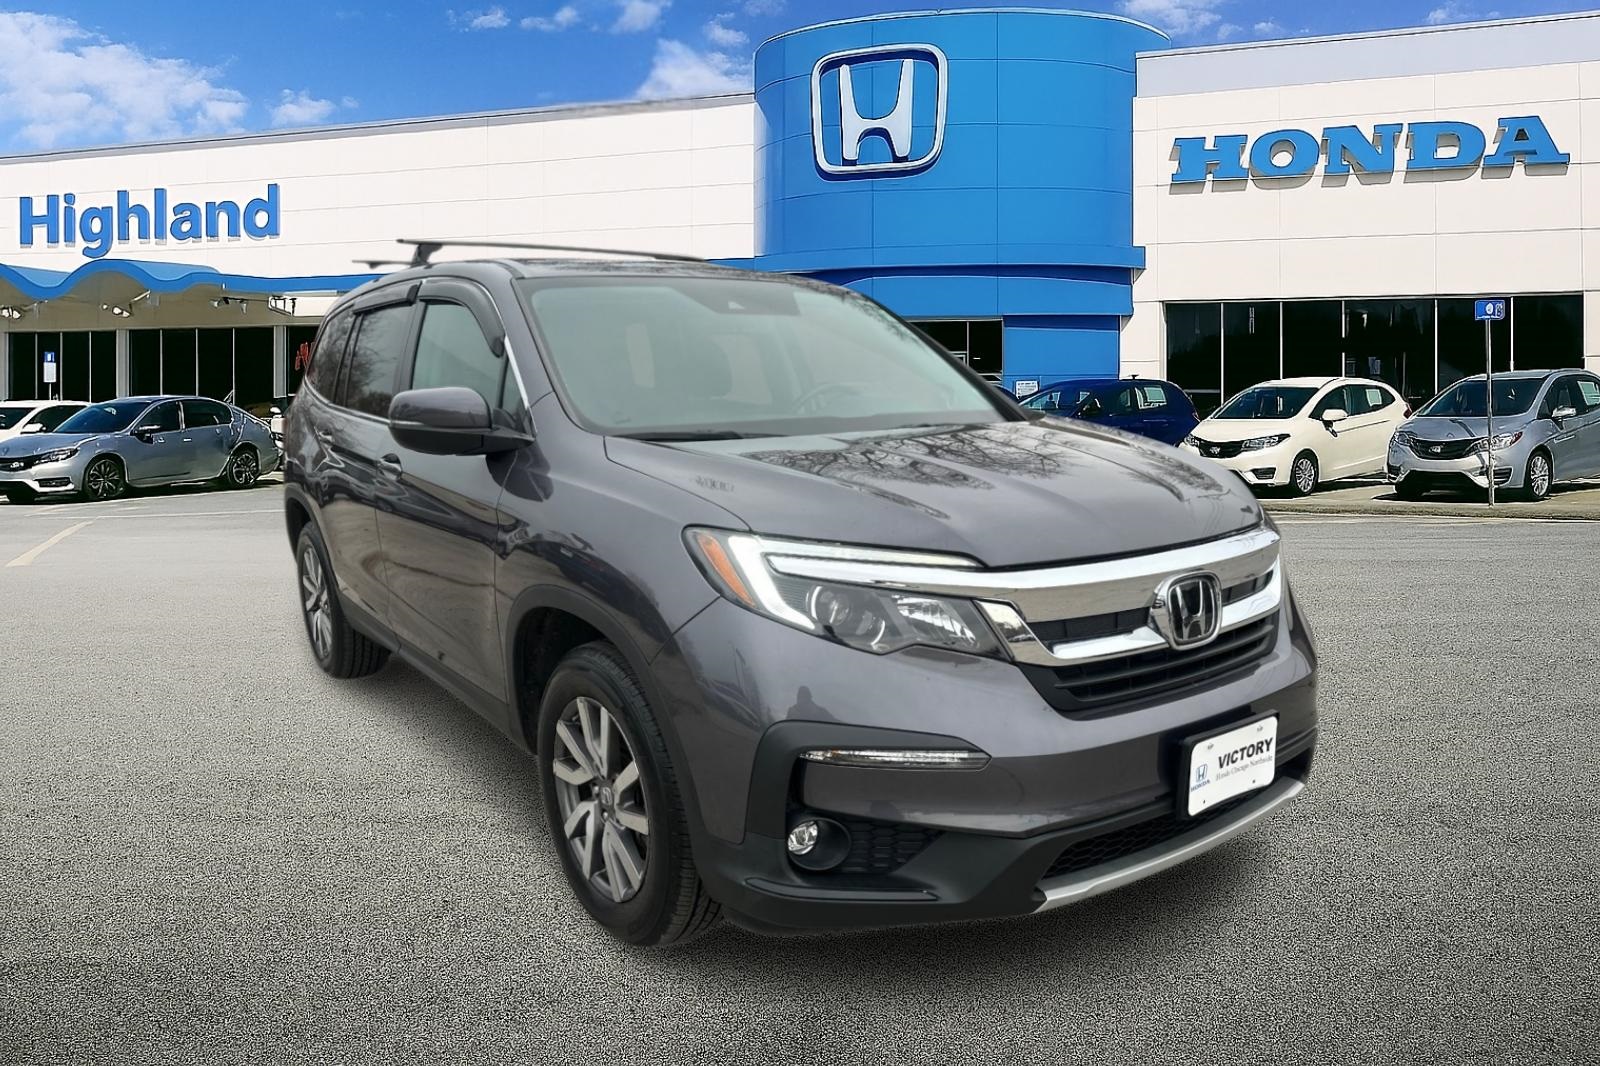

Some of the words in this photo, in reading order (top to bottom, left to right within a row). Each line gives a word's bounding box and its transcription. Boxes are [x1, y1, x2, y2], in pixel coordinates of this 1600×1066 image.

[1171, 115, 1571, 184] HONDA
[19, 183, 281, 259] Highland
[1218, 737, 1274, 769] VICTORY
[1190, 778, 1211, 793] HONDA
